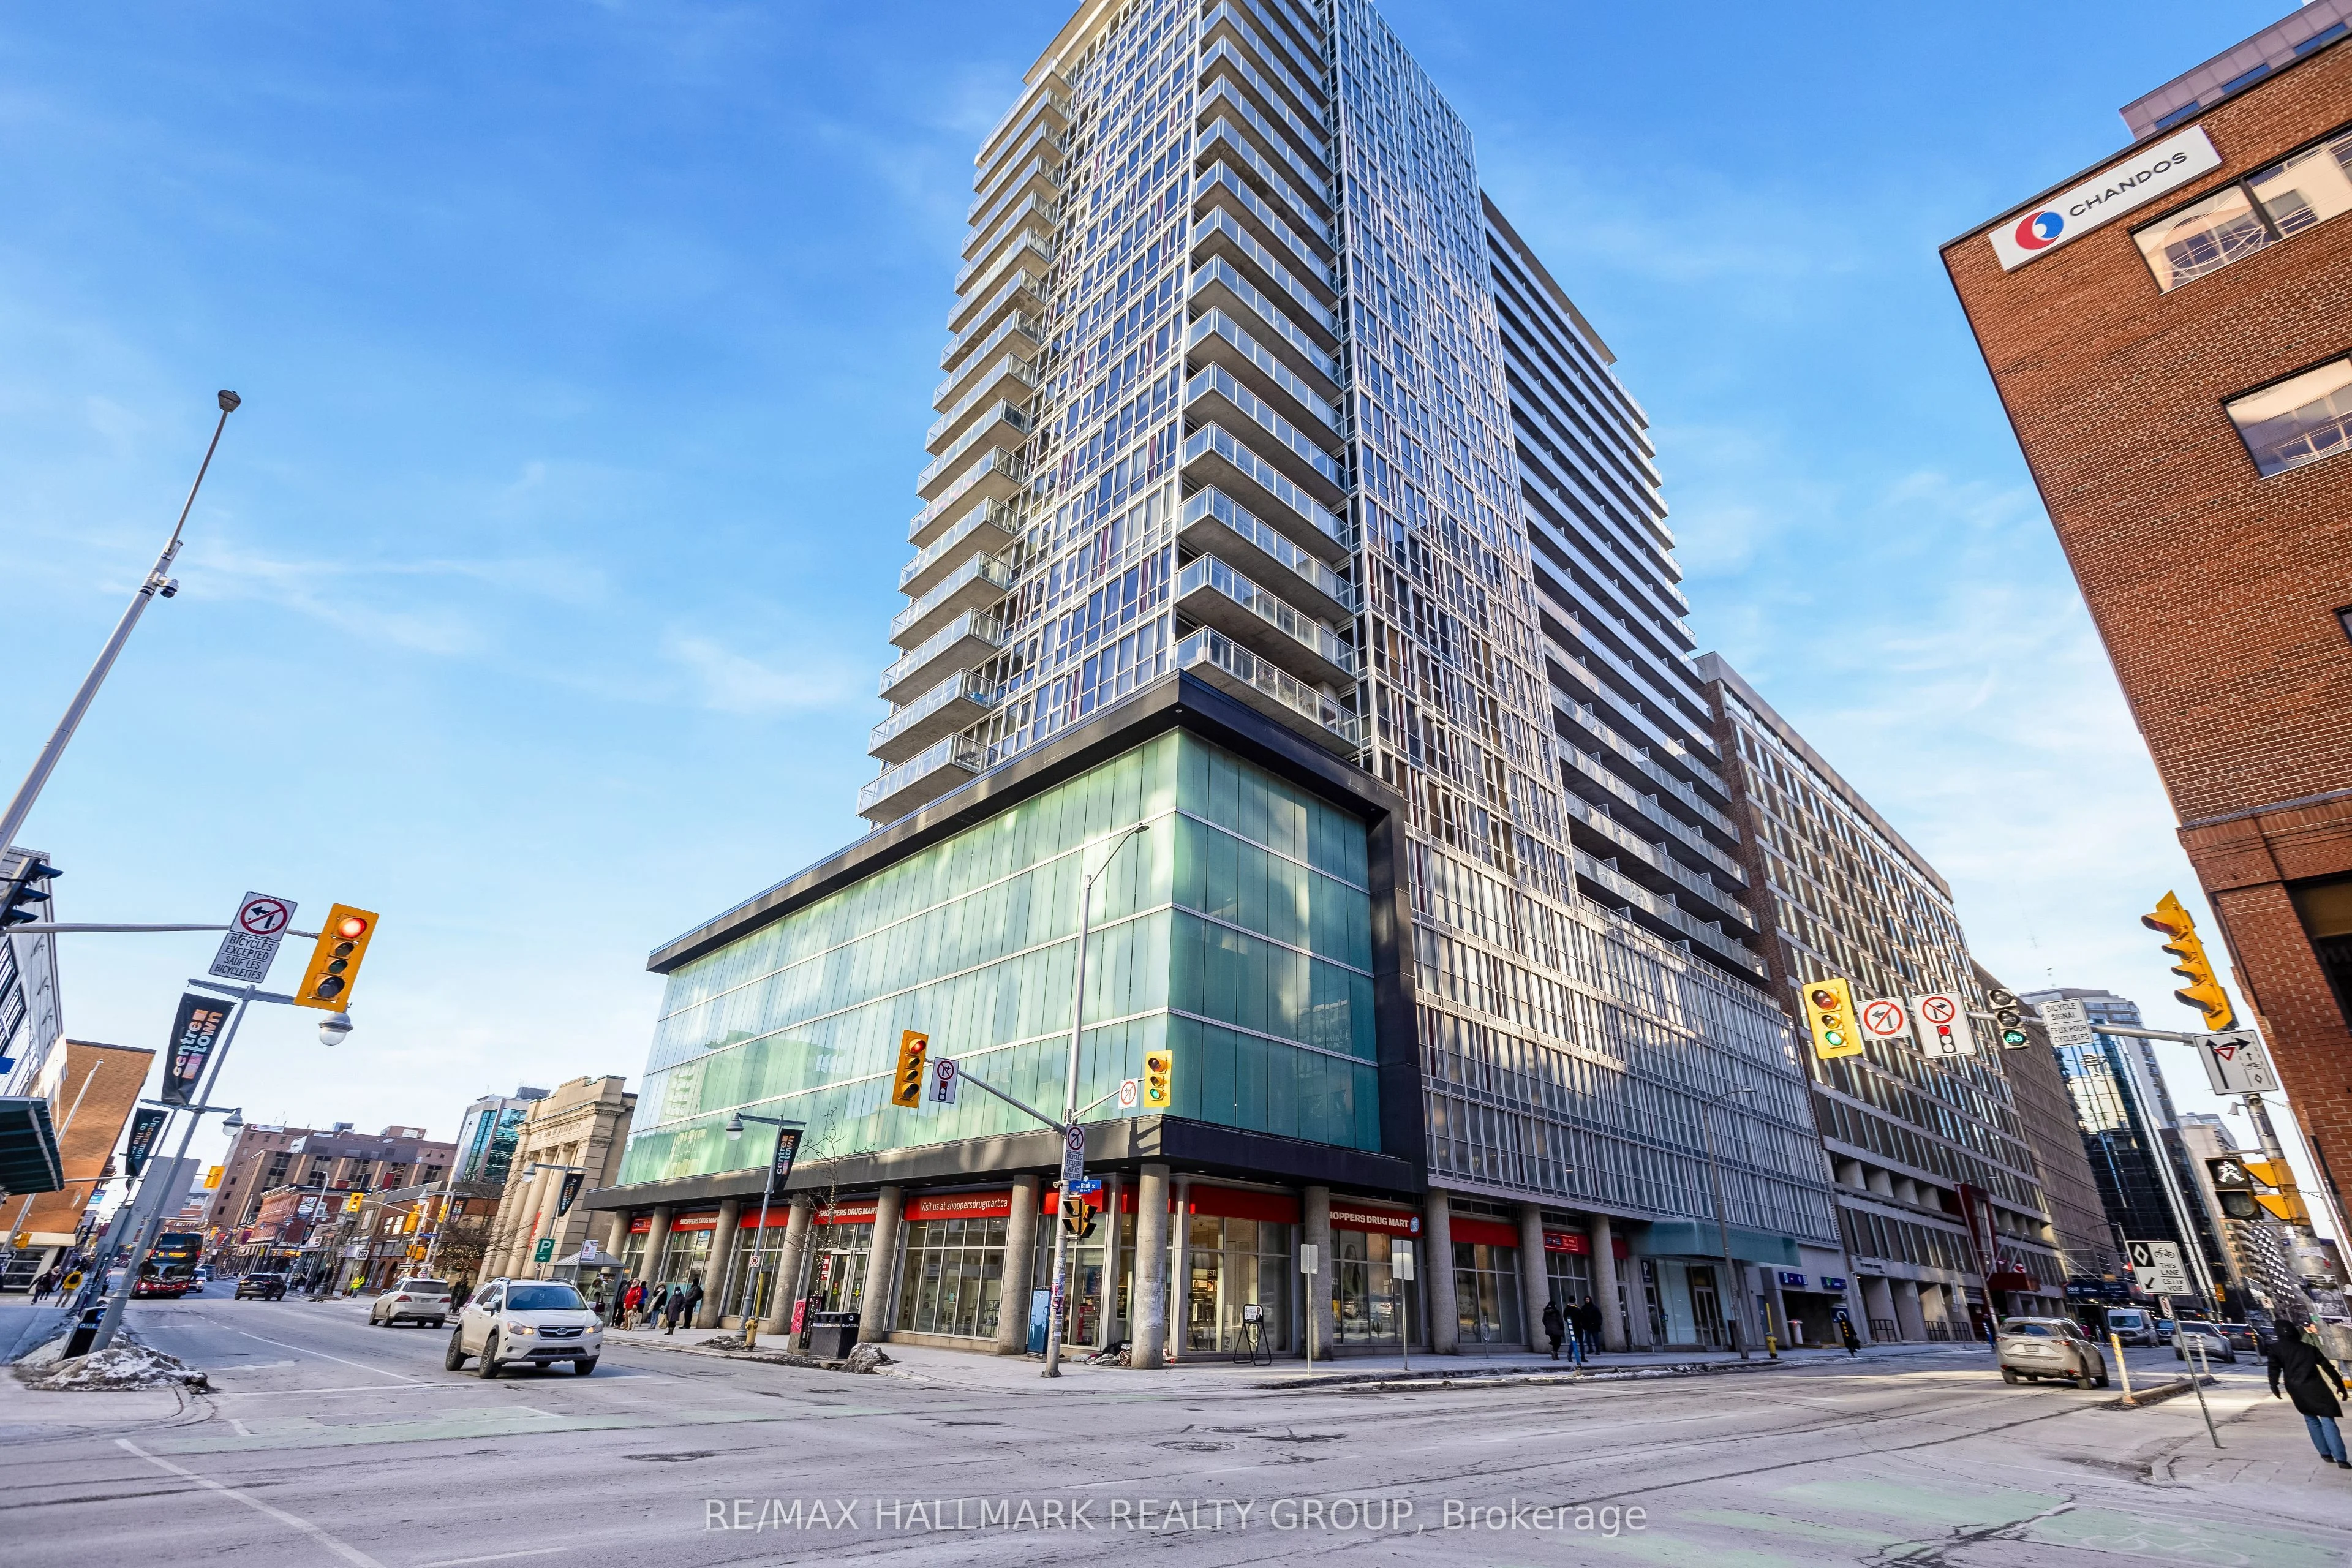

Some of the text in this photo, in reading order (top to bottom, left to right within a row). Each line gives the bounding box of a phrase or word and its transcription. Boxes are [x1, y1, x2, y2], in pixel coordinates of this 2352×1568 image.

[2070, 152, 2187, 216] CHANDOS
[229, 936, 274, 951] BICYCLES
[225, 945, 270, 960] EXCEPTED
[224, 956, 262, 970] SAUF LES
[214, 964, 262, 980] BICYCLETTES
[2046, 1003, 2078, 1012] BICYCLE
[2051, 1012, 2078, 1020] SIGNAL
[193, 1012, 224, 1052] town
[2054, 1033, 2090, 1043] CYCLISTES
[173, 1021, 202, 1076] centre
[135, 1117, 162, 1159] Uncommon
[785, 1136, 794, 1159] town
[777, 1142, 786, 1174] centre
[921, 1202, 932, 1212] Visit
[940, 1202, 946, 1211] at
[946, 1198, 1008, 1212] shoppersdrugmart.ca
[1330, 1211, 1409, 1227] HOPPERS DRUG MART
[540, 1240, 551, 1253] P
